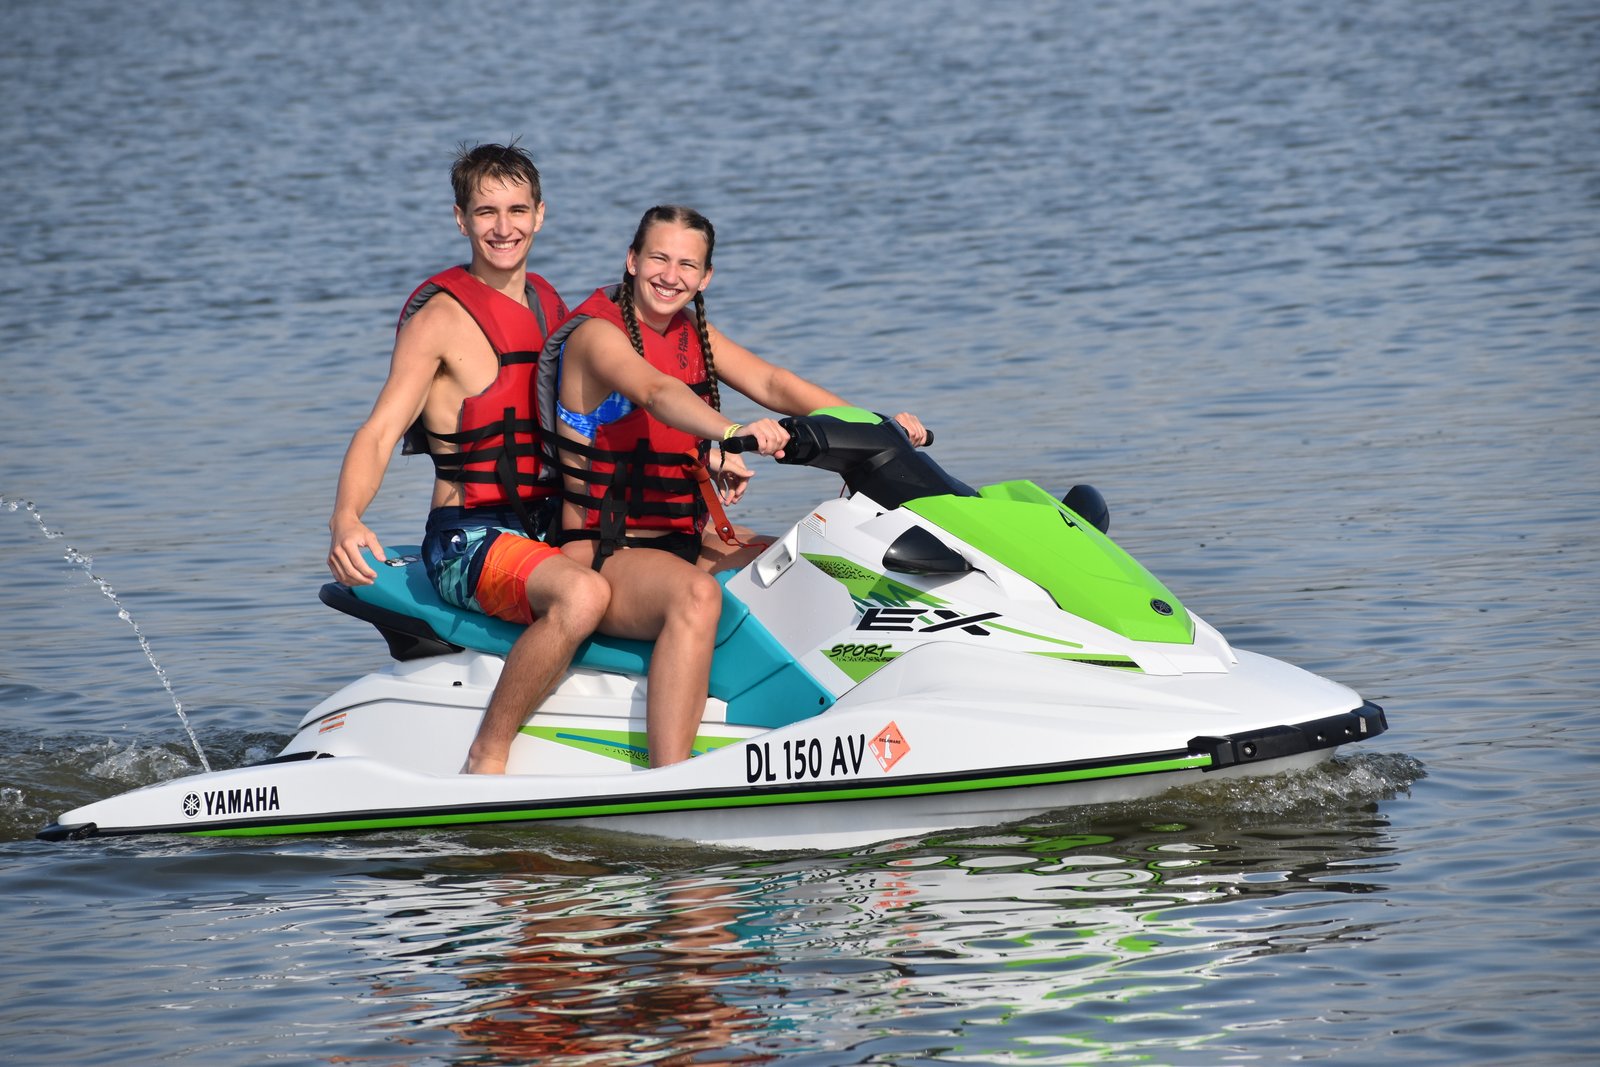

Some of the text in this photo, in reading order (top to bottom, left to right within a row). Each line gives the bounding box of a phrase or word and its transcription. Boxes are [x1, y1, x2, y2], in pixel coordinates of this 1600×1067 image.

[856, 608, 1003, 636] EX
[829, 644, 892, 657] SPORT
[746, 734, 865, 783] DL 150 AV
[204, 786, 280, 815] YAMAHA
